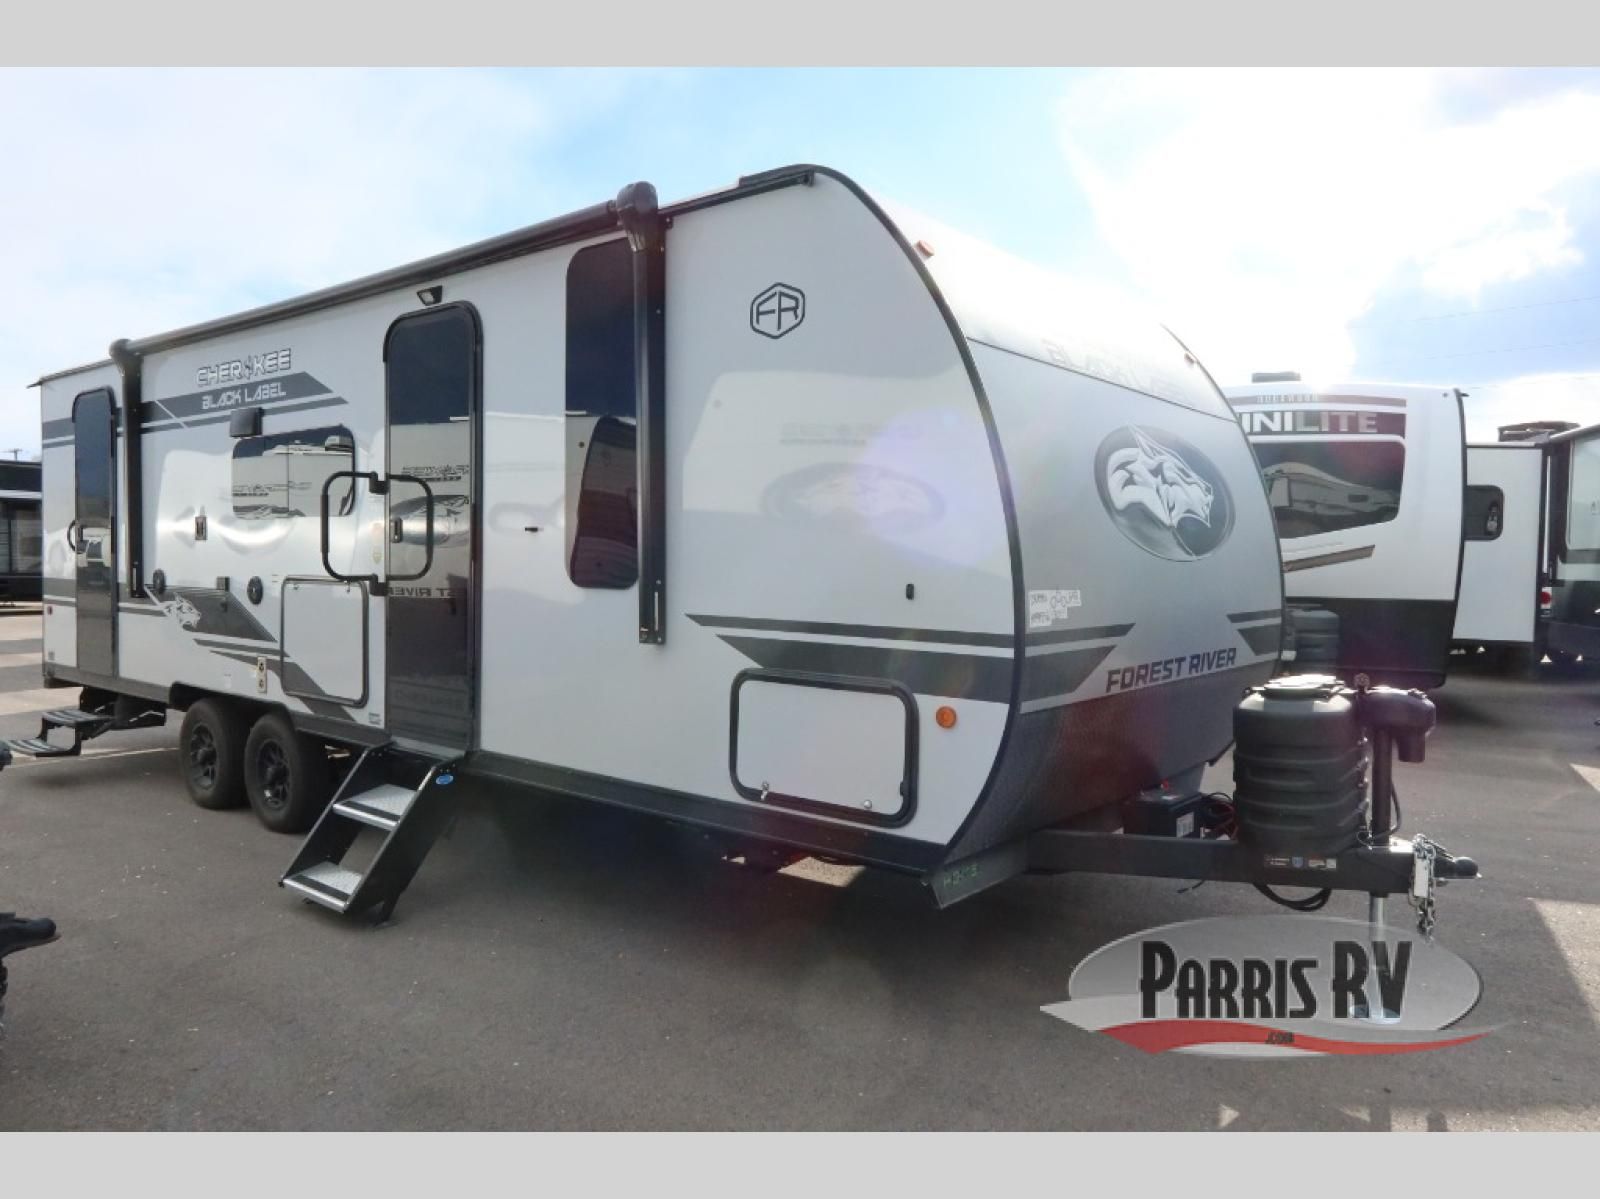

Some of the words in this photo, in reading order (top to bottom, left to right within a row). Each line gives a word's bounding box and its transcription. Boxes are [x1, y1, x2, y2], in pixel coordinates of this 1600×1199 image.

[756, 290, 799, 331] FR
[202, 389, 242, 410] BLACK
[244, 382, 287, 403] LABEL
[1235, 410, 1378, 433] INILITE
[1106, 656, 1187, 694] FOREST
[1188, 647, 1237, 676] RIVER
